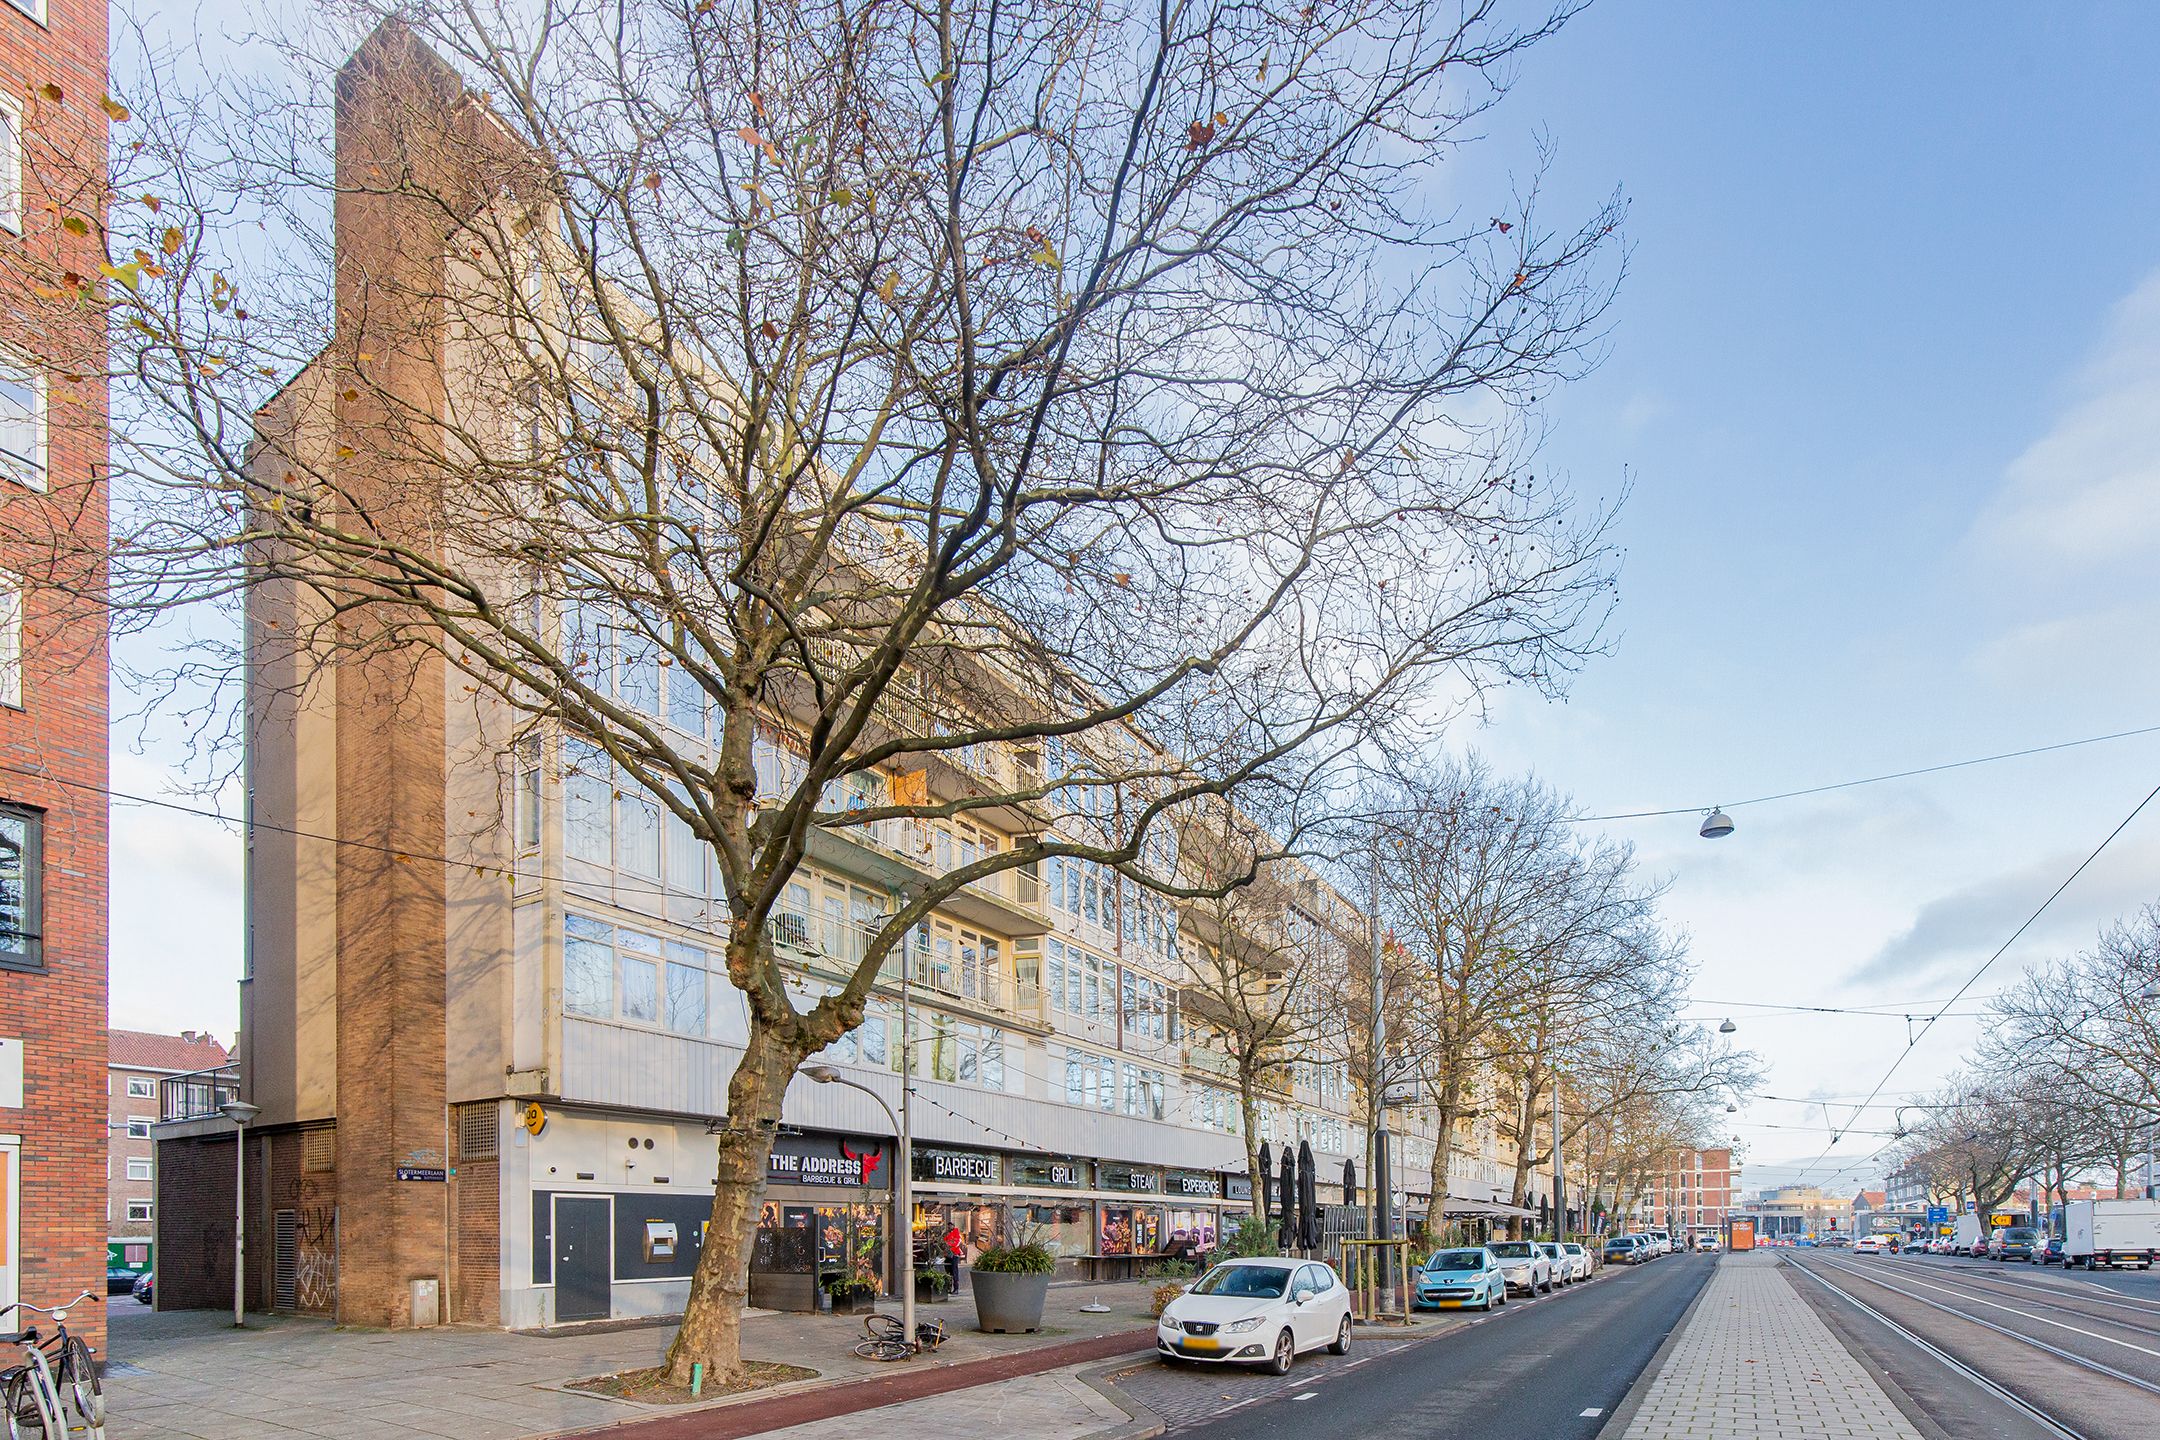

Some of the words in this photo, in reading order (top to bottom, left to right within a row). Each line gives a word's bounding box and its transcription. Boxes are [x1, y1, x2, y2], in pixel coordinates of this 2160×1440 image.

[770, 1153, 798, 1171] THE
[801, 1156, 861, 1175] ADDRESS
[936, 1156, 998, 1179] BARBECUE
[1052, 1166, 1078, 1184] GRILL
[1130, 1173, 1155, 1190] STEAK
[1182, 1178, 1220, 1194] EXPERIENCE
[802, 1174, 836, 1184] BARBECUE
[837, 1176, 842, 1184] &
[843, 1176, 861, 1185] GRILL
